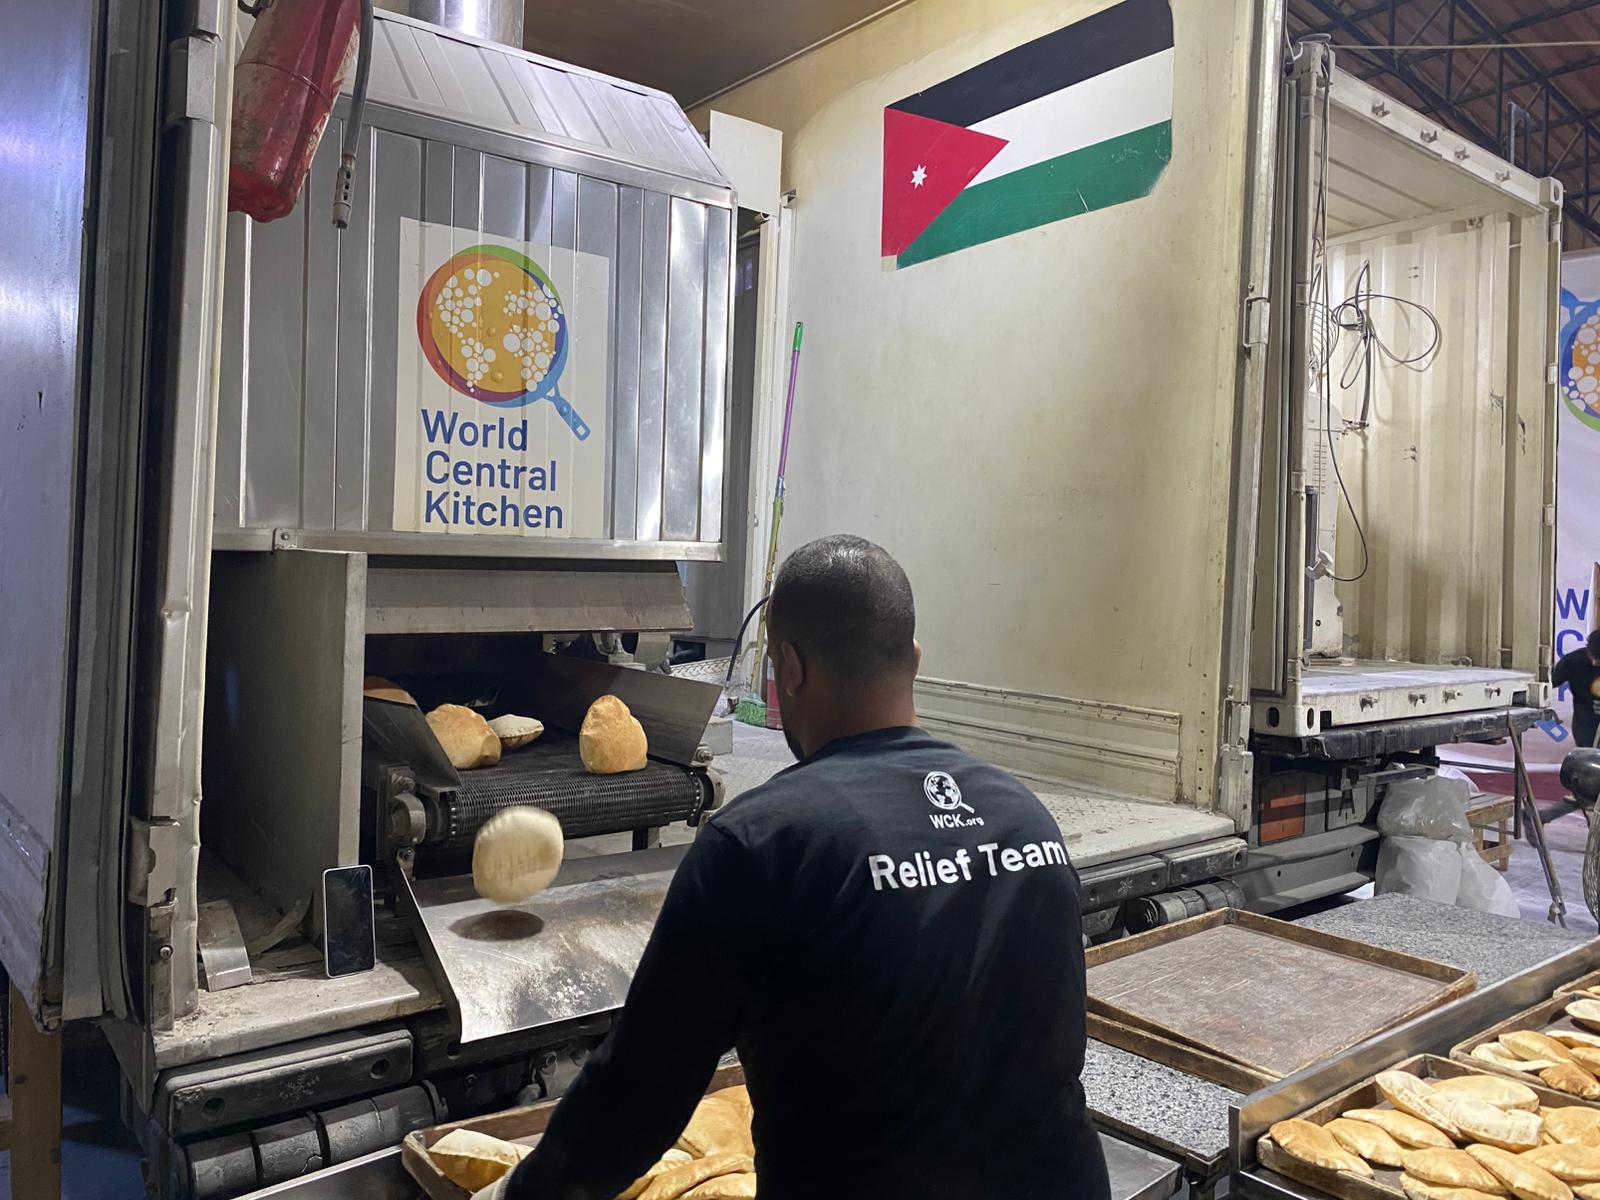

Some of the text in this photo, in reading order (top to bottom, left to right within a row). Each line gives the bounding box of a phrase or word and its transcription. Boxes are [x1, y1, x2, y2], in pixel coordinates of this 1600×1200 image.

[421, 408, 528, 452] World
[426, 450, 556, 491] Central
[425, 490, 563, 528] Kitchen
[929, 813, 985, 829] WCK.org
[868, 840, 1068, 891] Relief Team
